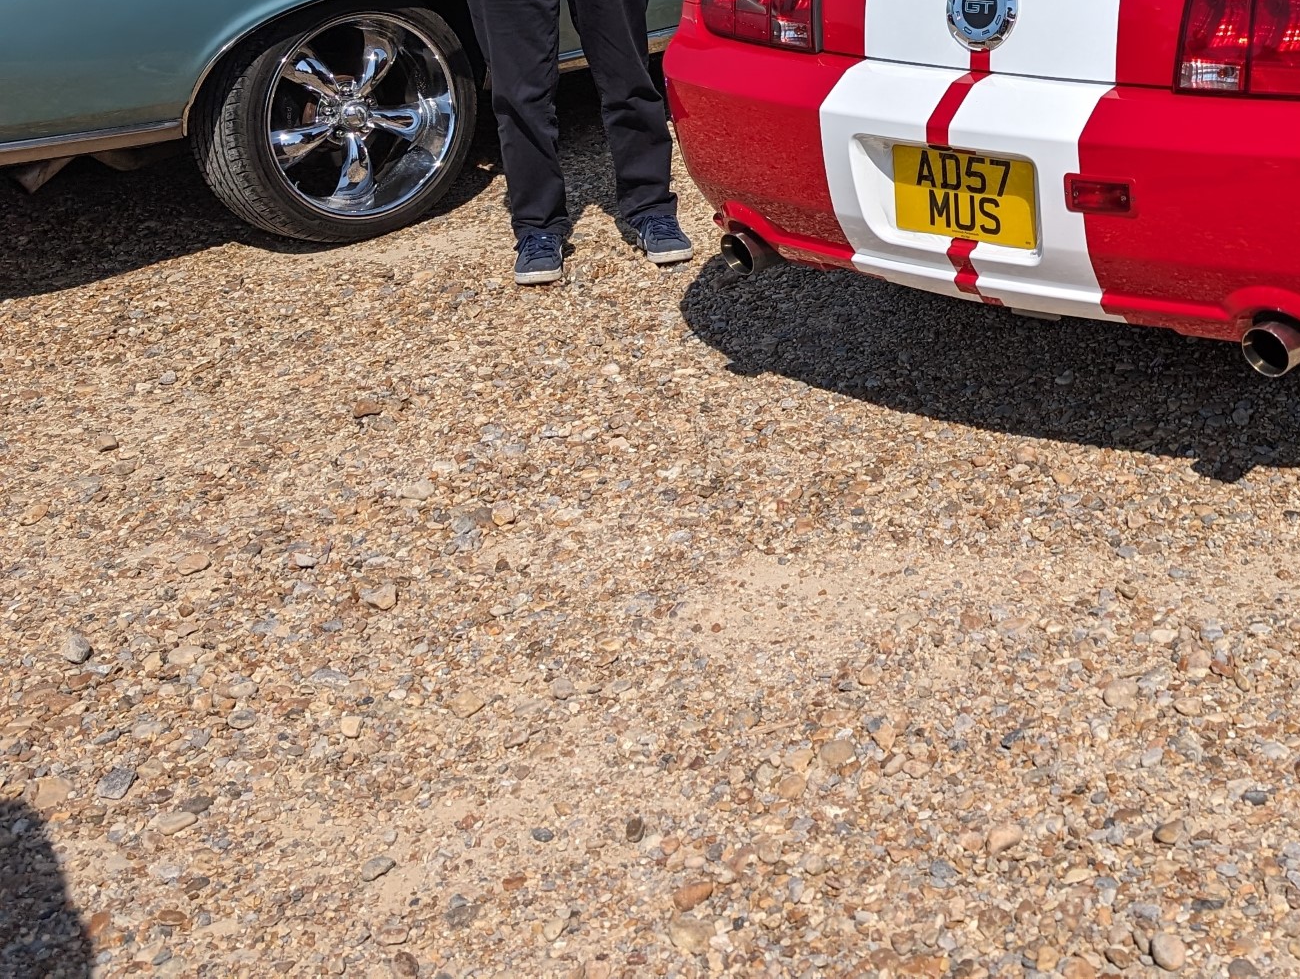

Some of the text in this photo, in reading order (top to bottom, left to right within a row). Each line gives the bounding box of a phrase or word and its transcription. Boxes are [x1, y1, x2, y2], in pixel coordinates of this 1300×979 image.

[964, 0, 994, 15] GT
[916, 150, 1011, 197] AD57
[929, 189, 1001, 236] MUS
